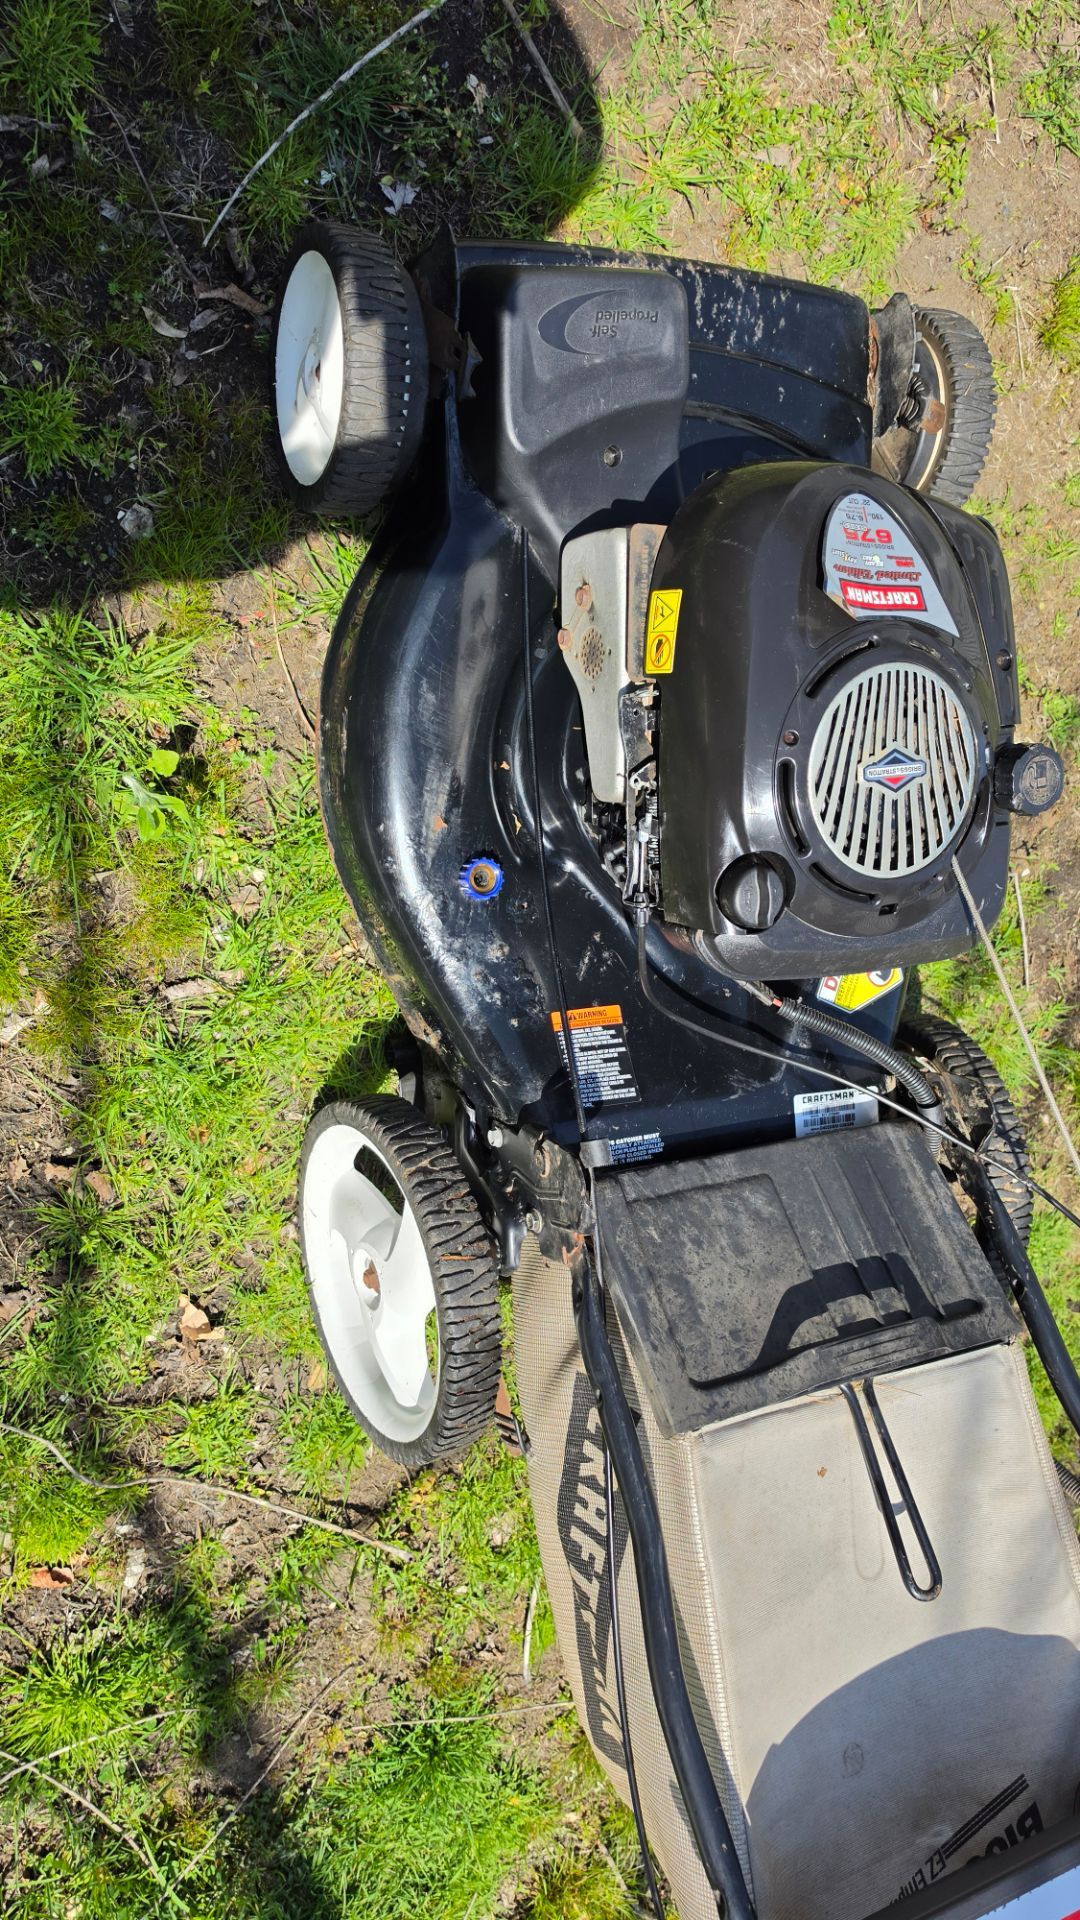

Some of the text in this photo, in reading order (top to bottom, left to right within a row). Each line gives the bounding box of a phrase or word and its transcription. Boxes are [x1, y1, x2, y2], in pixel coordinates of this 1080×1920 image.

[595, 308, 659, 323] Propelled
[589, 325, 618, 338] Self-
[843, 528, 893, 544] 675
[833, 563, 922, 581] Limited Edition
[847, 587, 918, 605] CRAFTSMAN
[868, 768, 897, 776] STRATTON
[901, 766, 922, 774] BRIGGS
[577, 1009, 607, 1020] WARNING
[802, 1091, 855, 1104] CRAFTSMAN
[925, 1848, 947, 1881] EZ
